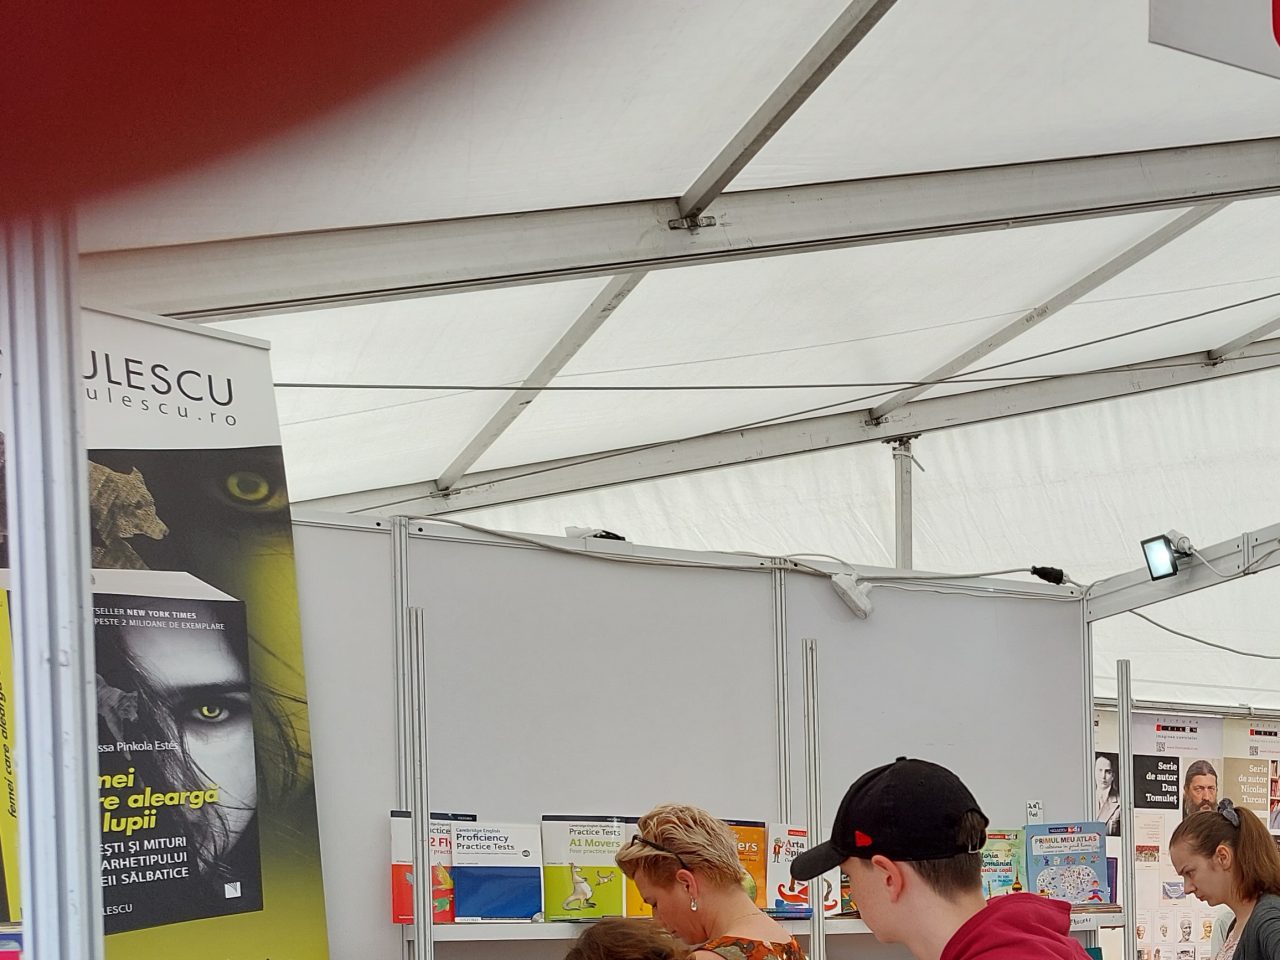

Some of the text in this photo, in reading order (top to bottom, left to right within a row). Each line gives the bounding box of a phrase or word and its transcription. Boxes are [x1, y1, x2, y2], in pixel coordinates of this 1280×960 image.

[82, 350, 233, 407] ULESCU
[86, 386, 237, 427] ulescu.ro
[92, 607, 197, 620] SELLER NEW YORK TIMES
[94, 617, 225, 631] PESTE 2 MILIOANE DE EXEMPLARE
[117, 740, 153, 752] Pinkola
[1158, 761, 1177, 771] Serie
[1249, 765, 1267, 773] Serie
[1157, 773, 1177, 782] autor
[1248, 775, 1267, 784] autor
[1162, 783, 1177, 792] Dan
[1241, 785, 1267, 794] Nicolae
[128, 783, 219, 809] aleargă
[103, 809, 157, 836] lupii
[569, 828, 600, 836] Practice
[456, 833, 509, 844] Proficiency
[569, 838, 621, 848] A1 Movers
[1034, 837, 1059, 845] PRIMUL
[1076, 835, 1097, 843] ATLAS
[99, 841, 125, 856] EŞTI
[143, 836, 187, 852] MITURI
[456, 843, 515, 851] Practice Tests
[101, 851, 187, 871] ARHETIPULUI
[101, 867, 189, 887] EII SĂLBATICE
